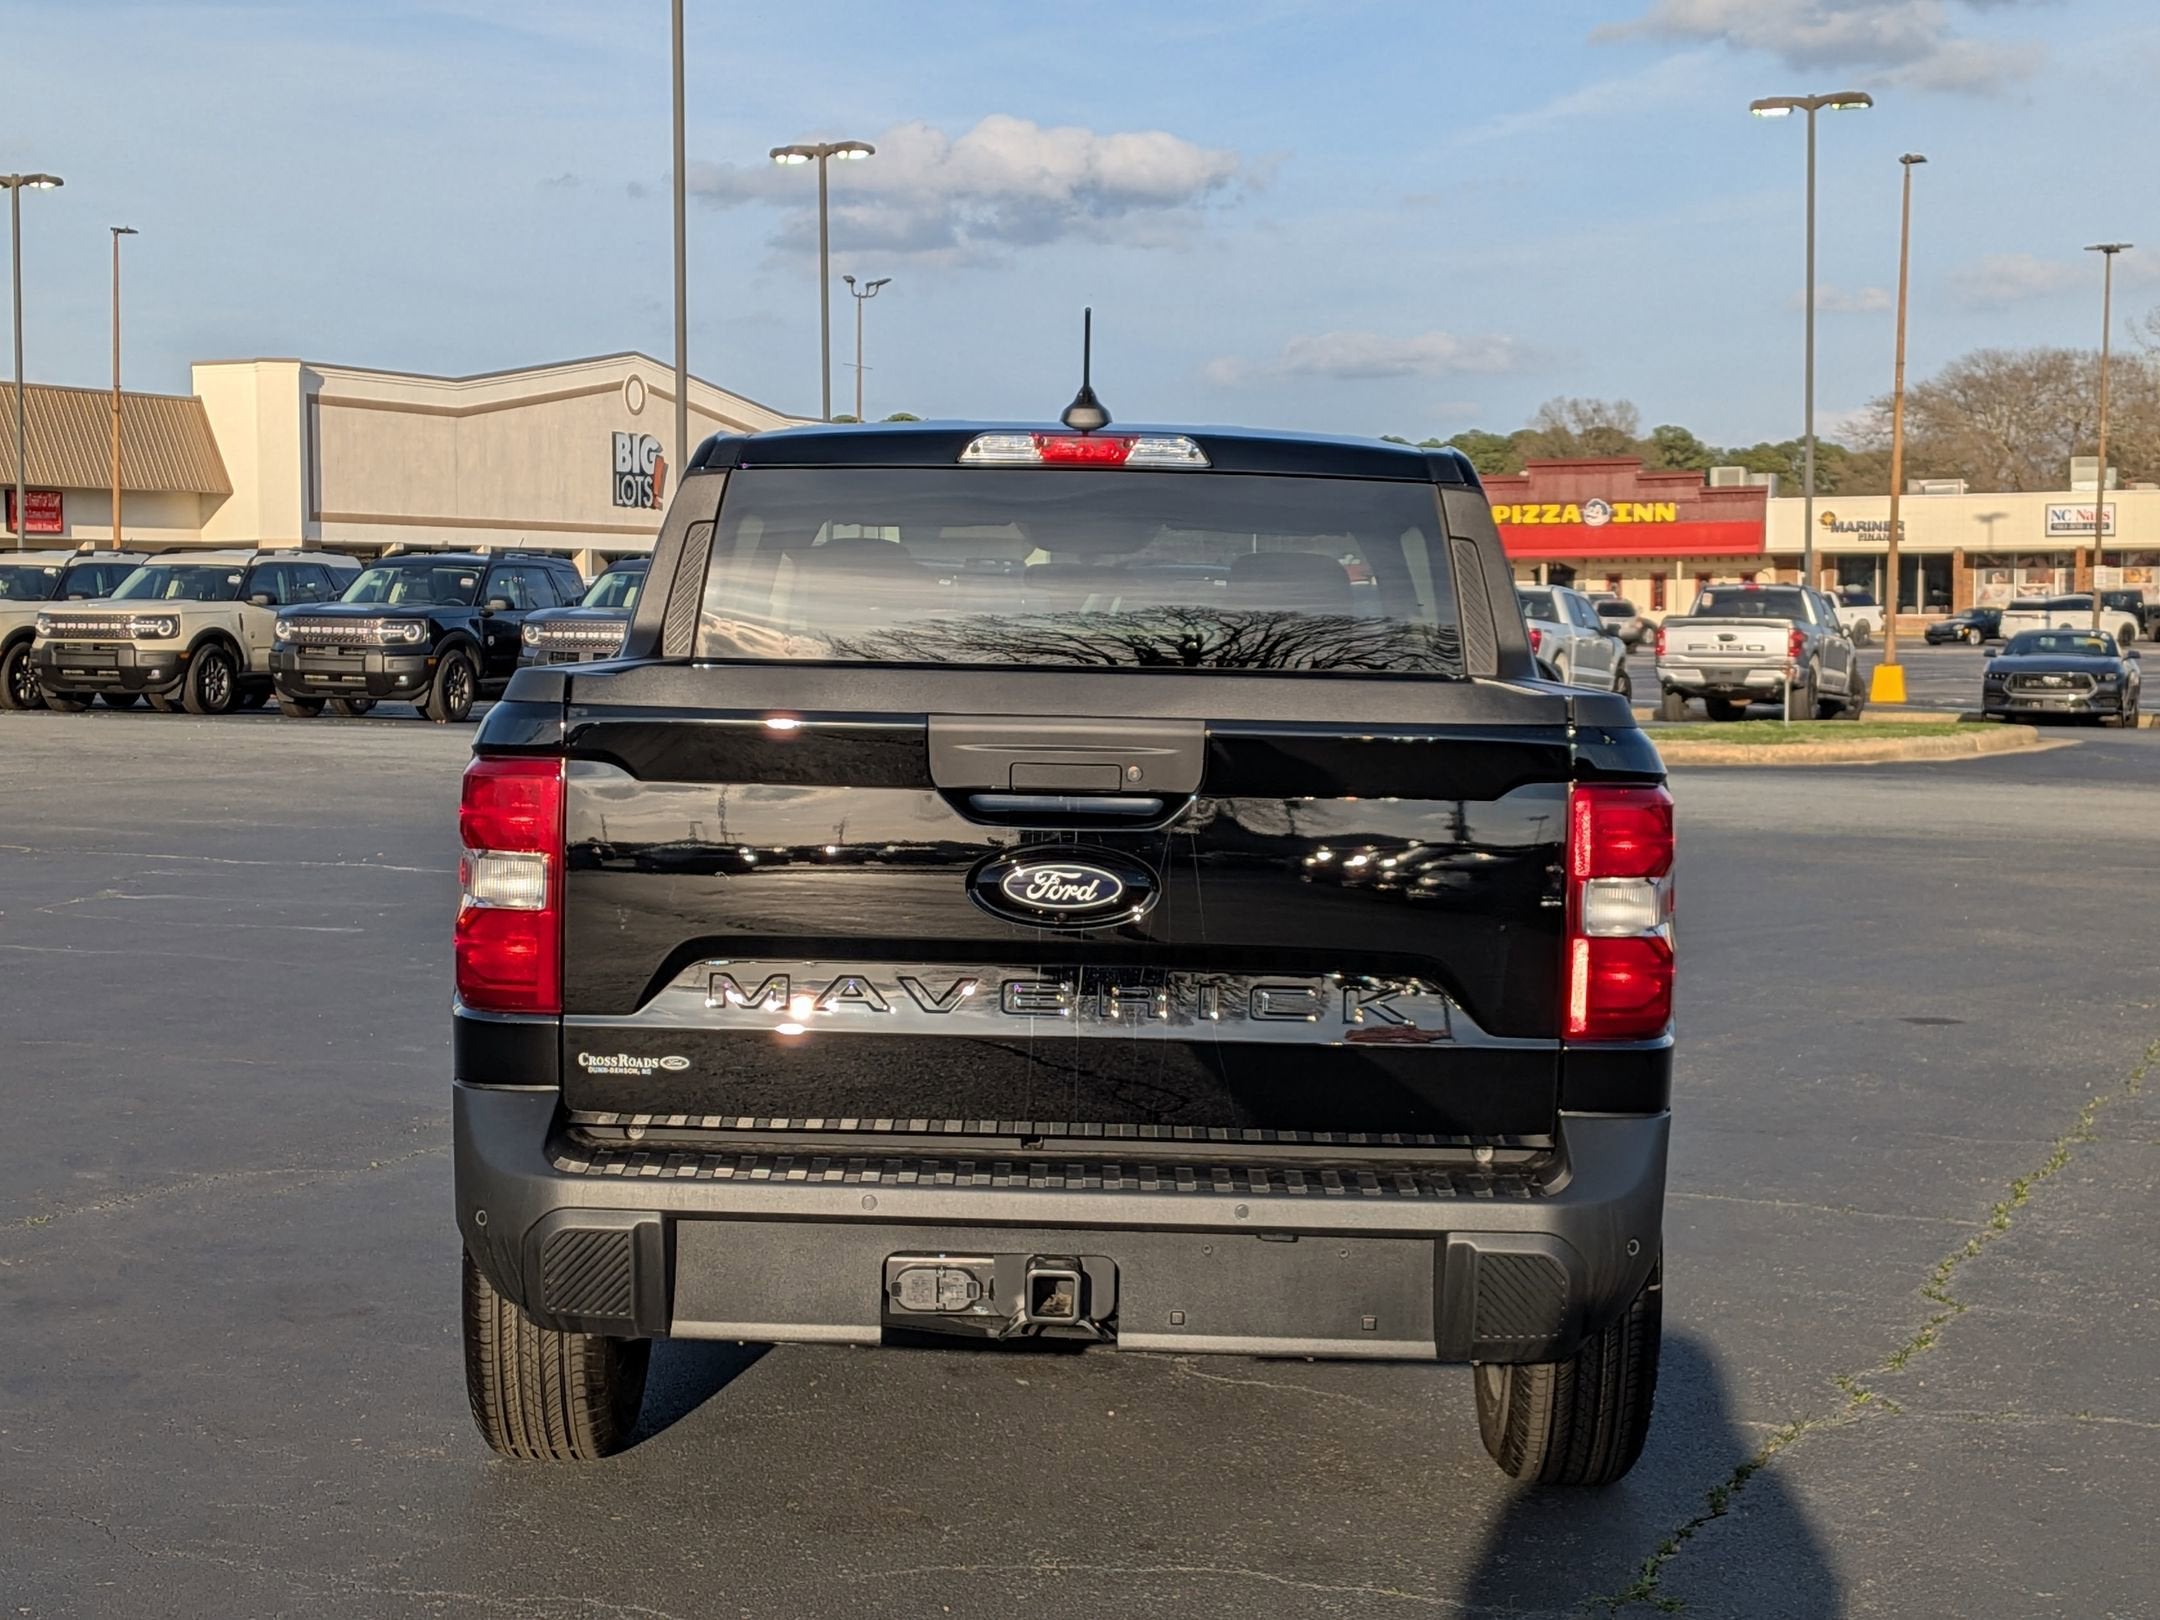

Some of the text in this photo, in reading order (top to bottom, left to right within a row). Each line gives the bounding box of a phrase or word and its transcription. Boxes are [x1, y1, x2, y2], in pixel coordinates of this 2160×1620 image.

[615, 433, 660, 475] BIG
[1491, 503, 1677, 524] PIZZA INN
[2051, 509, 2111, 522] NC Nas
[1830, 520, 1905, 533] MARINER
[1857, 532, 1906, 542] FINANE
[1687, 643, 1766, 652] F-150
[1026, 861, 1101, 901] Ford
[706, 972, 1416, 1026] MAVERICK
